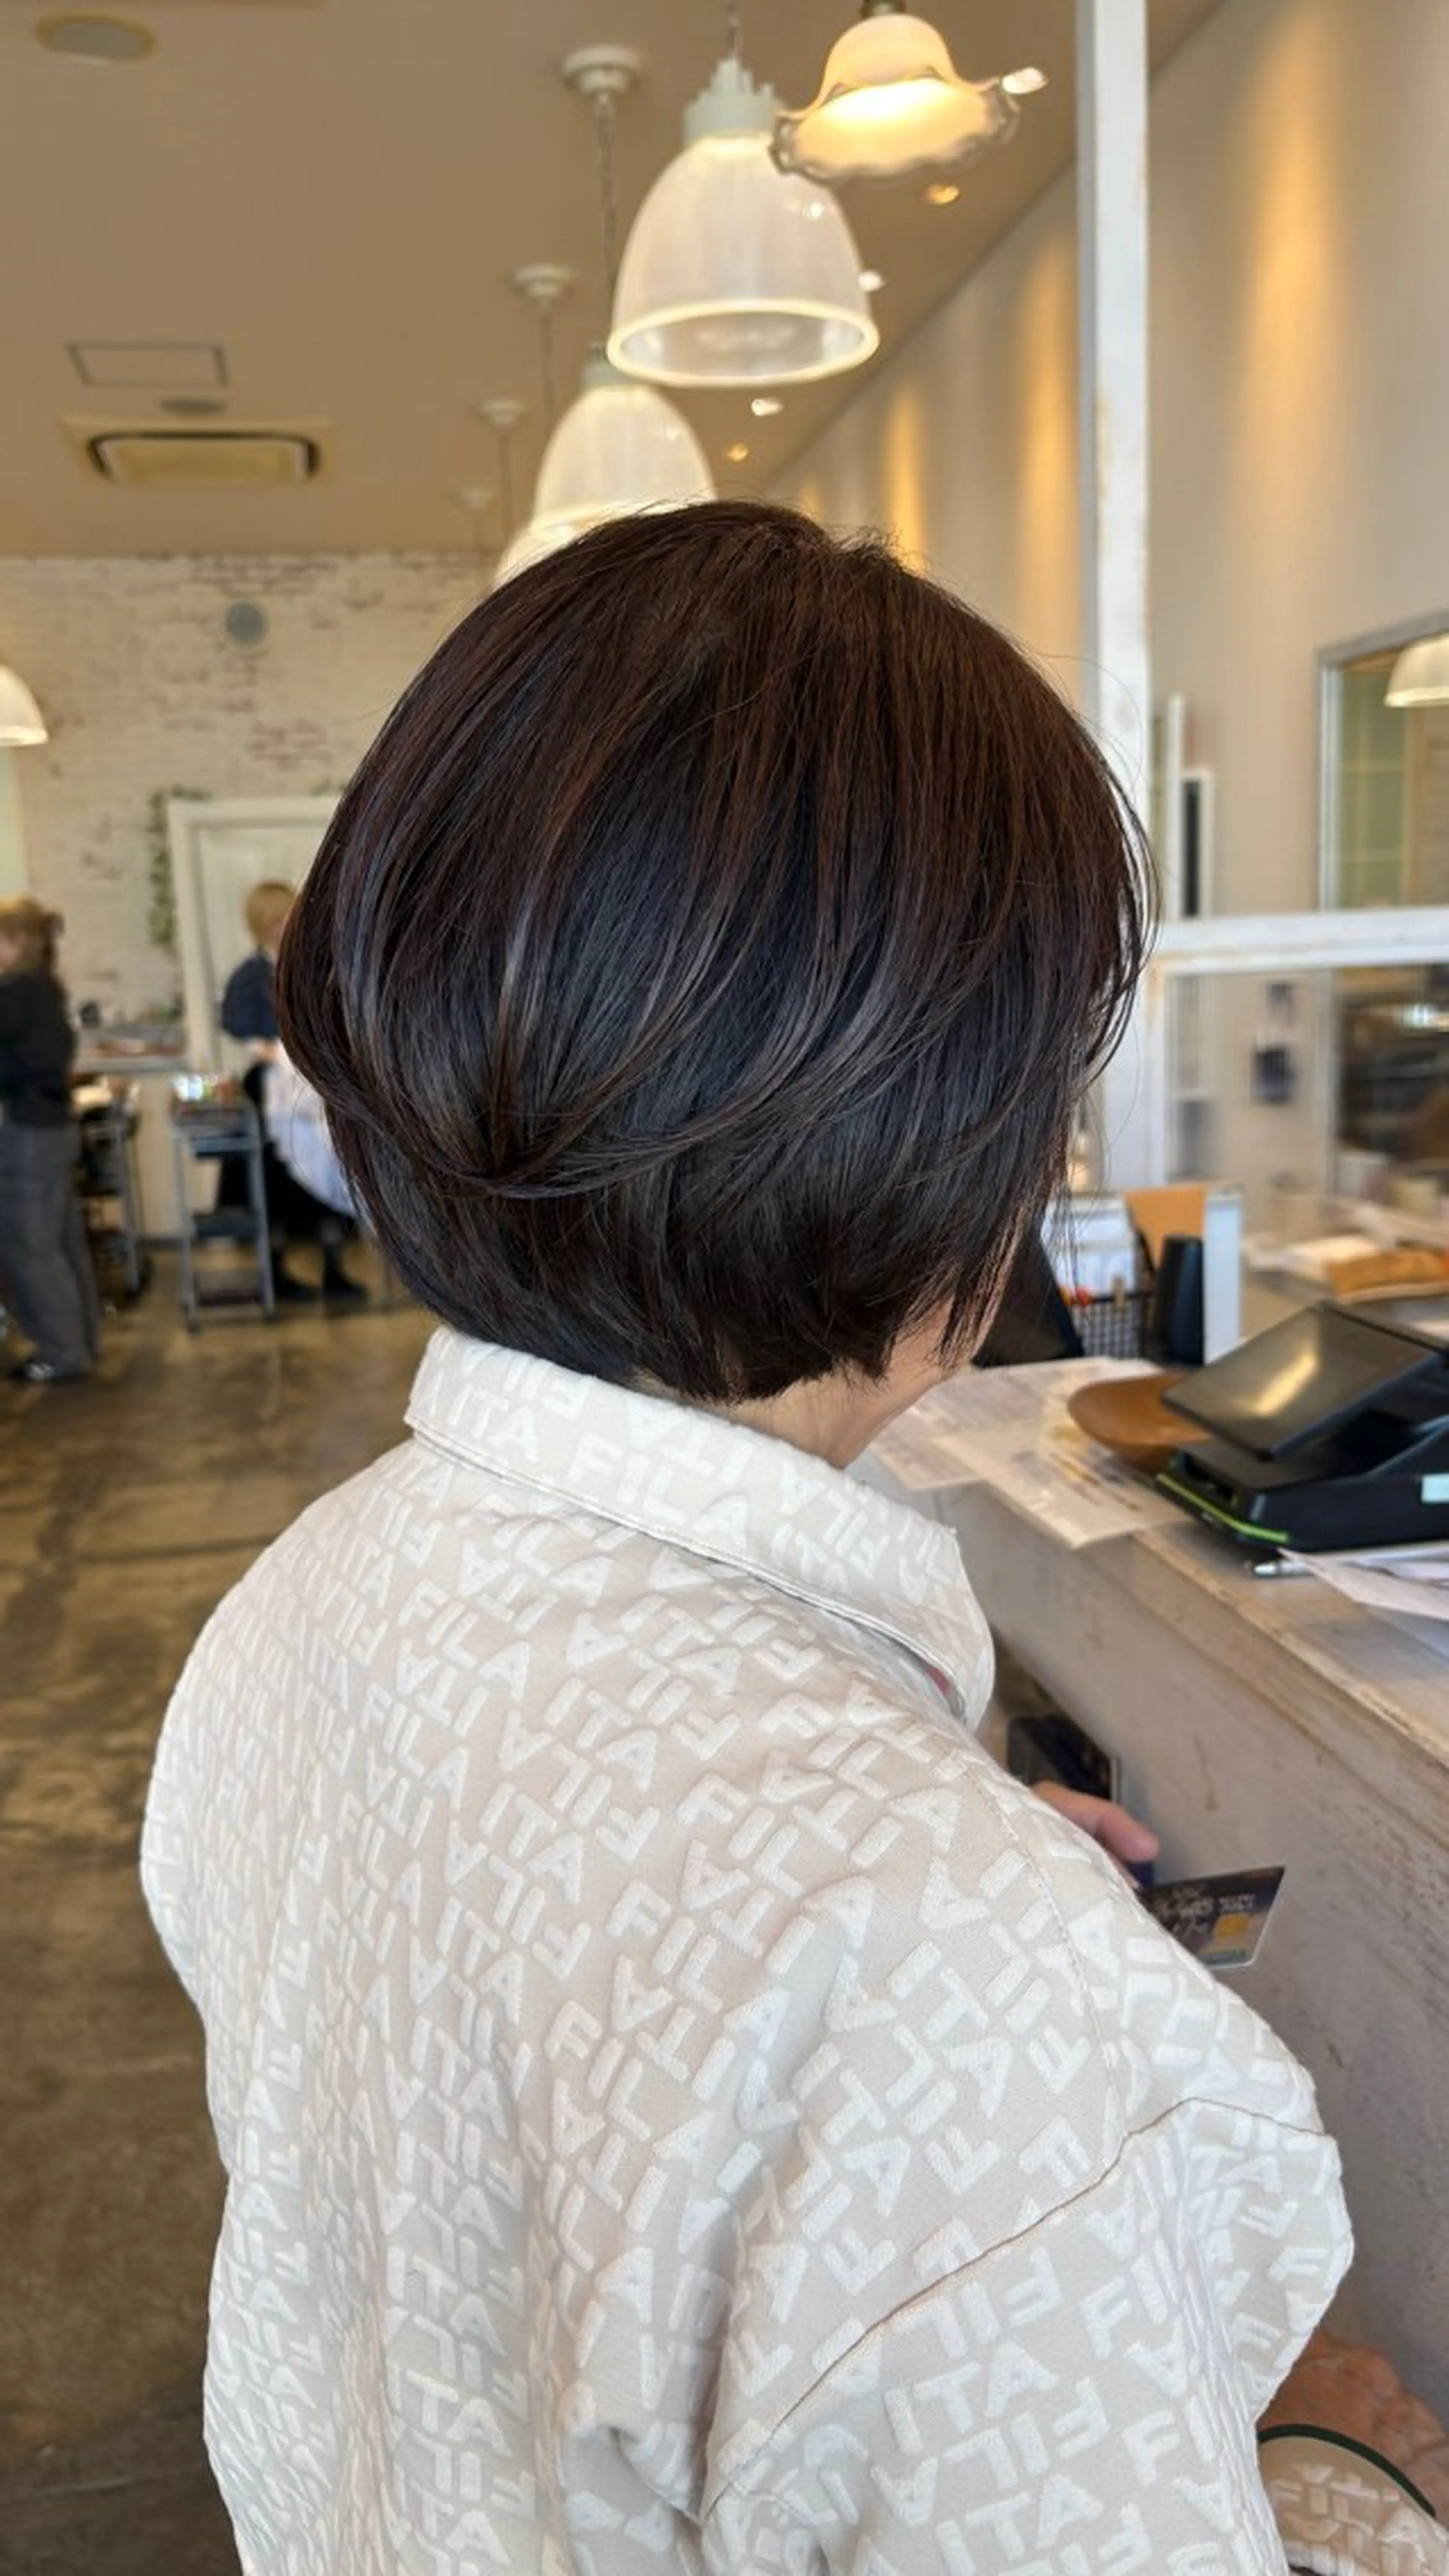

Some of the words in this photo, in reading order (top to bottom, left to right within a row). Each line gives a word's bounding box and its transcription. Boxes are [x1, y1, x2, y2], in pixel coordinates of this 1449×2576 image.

[444, 1382, 537, 1463] ITA
[565, 1430, 748, 1553] FILA
[460, 1538, 563, 1636] ITA
[400, 1637, 490, 1738] ITA
[568, 1613, 740, 1762] FILA
[617, 1591, 743, 1700] ITA
[757, 1692, 963, 1853] FILA
[369, 1747, 434, 1850] ITA
[395, 1576, 530, 1702] FILA
[542, 1674, 657, 1795] ITA
[674, 1770, 876, 1951] FILA
[883, 1938, 1014, 2121] ITA
[501, 1710, 660, 1863] FILA
[761, 1749, 905, 1872] ITA
[343, 1856, 396, 1964] ITA
[362, 1682, 469, 1813] FILA
[480, 1780, 580, 1905] ITA
[602, 1877, 794, 2053] FILA
[789, 2040, 907, 2219] ITA
[446, 1818, 590, 1982] FILA
[686, 1838, 818, 1980] ITA
[924, 1856, 1091, 2095] FILA
[320, 1898, 390, 2043] FILA
[414, 2014, 506, 2141] ITA
[337, 1790, 419, 1926] FILA
[438, 1897, 523, 2024] ITA
[547, 1999, 714, 2178] FILA
[618, 1955, 741, 2103] ITA
[385, 2051, 522, 2213] FILA
[832, 1954, 1002, 2197] FILA
[395, 2132, 505, 2250] ITA
[560, 2081, 672, 2235] ITA
[391, 2246, 506, 2358] ITA
[869, 2376, 1112, 2528] FILA
[882, 2340, 1060, 2456] ITA
[934, 2472, 1106, 2576] ITA
